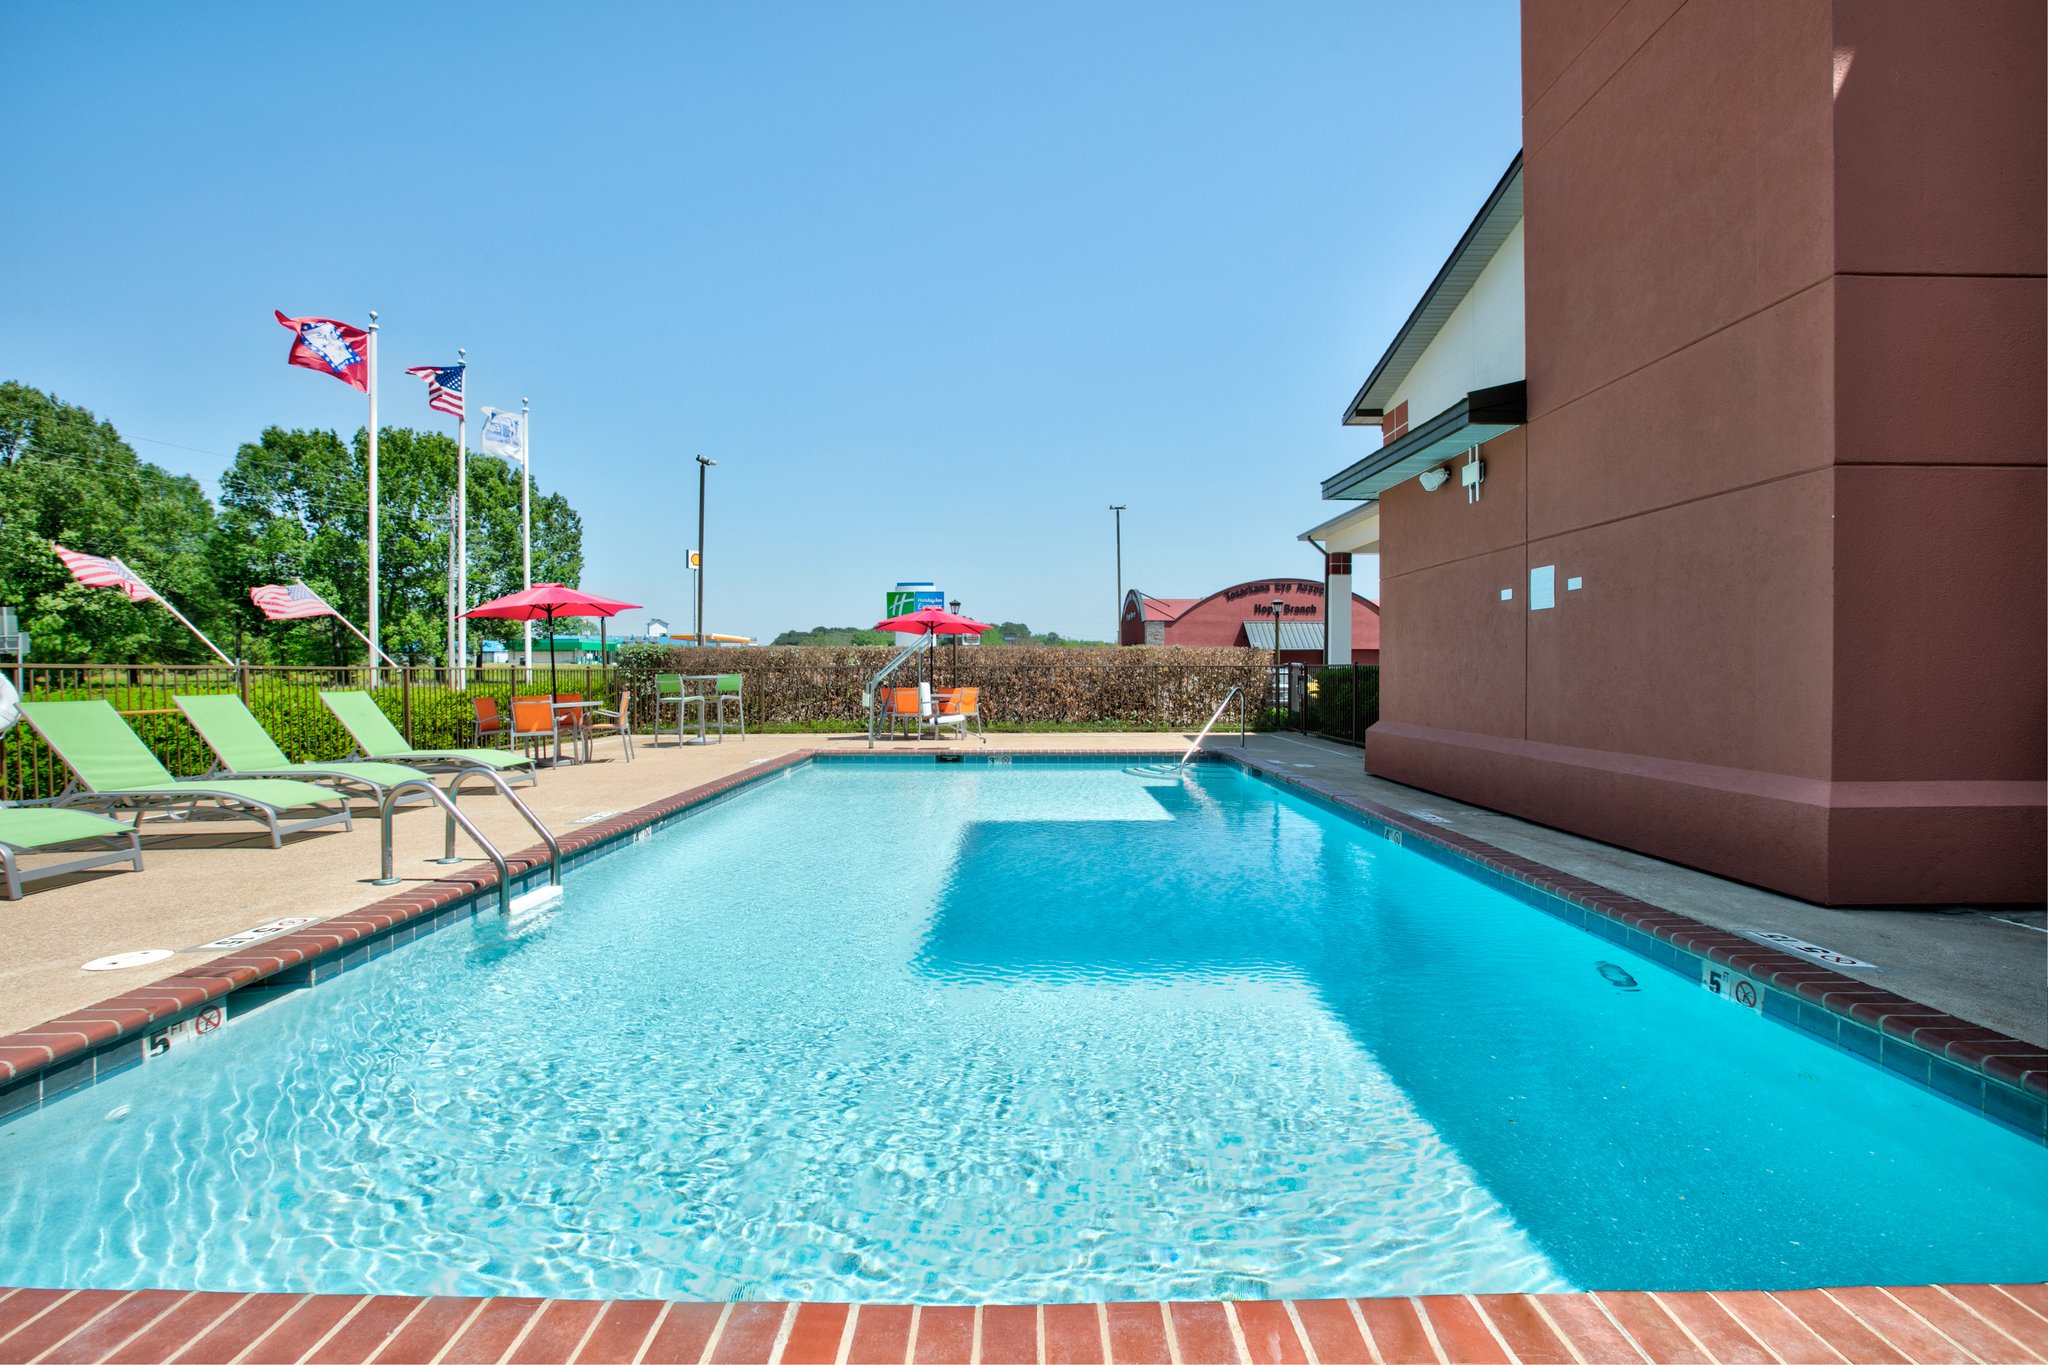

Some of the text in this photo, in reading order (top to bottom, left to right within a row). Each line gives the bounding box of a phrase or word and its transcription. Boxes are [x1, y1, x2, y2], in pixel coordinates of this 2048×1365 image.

[1224, 583, 1270, 601] Texarkana
[1275, 583, 1292, 594] Eye
[1284, 604, 1317, 616] Branch
[1709, 970, 1722, 994] 5
[150, 1030, 170, 1058] 5
